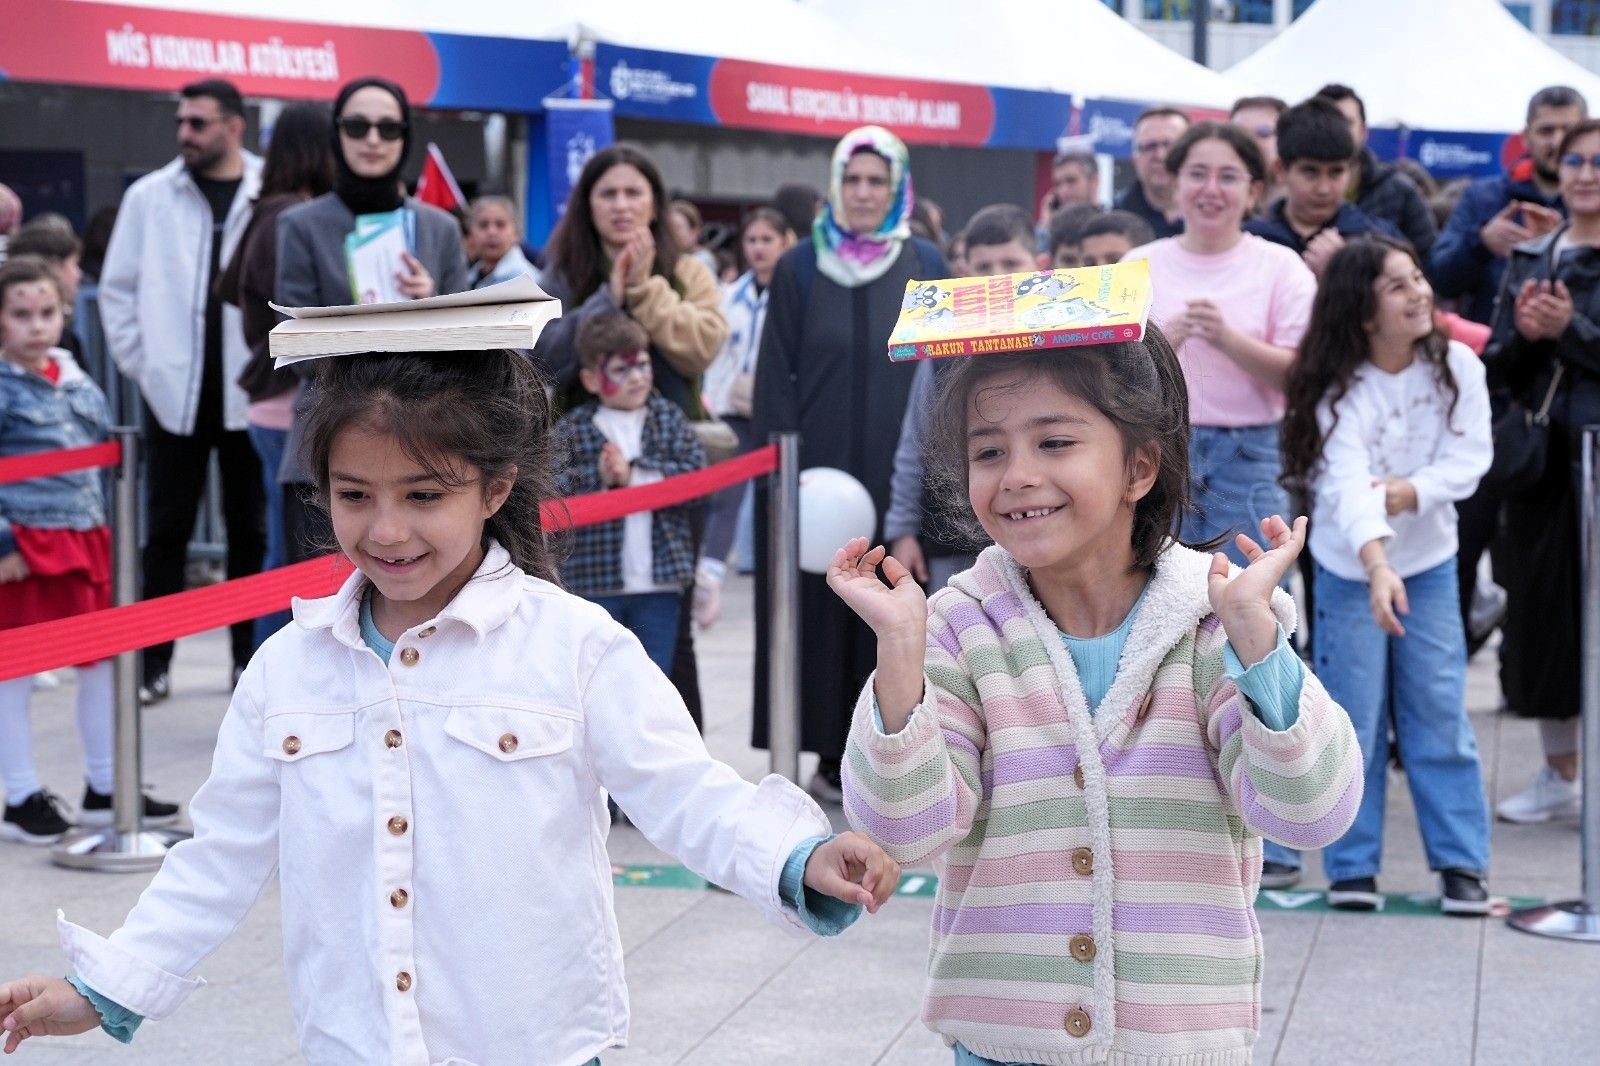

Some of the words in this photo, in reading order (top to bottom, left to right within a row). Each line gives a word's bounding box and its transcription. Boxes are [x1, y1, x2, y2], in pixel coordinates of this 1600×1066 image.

[106, 23, 150, 67] MİS
[151, 34, 247, 74] KOKULAR
[250, 37, 338, 81] ATÖLYESİ
[928, 341, 964, 355] RAKUN
[971, 336, 1033, 352] TANTANASI
[1052, 333, 1088, 344] ANDREW
[1091, 330, 1115, 341] COPE
